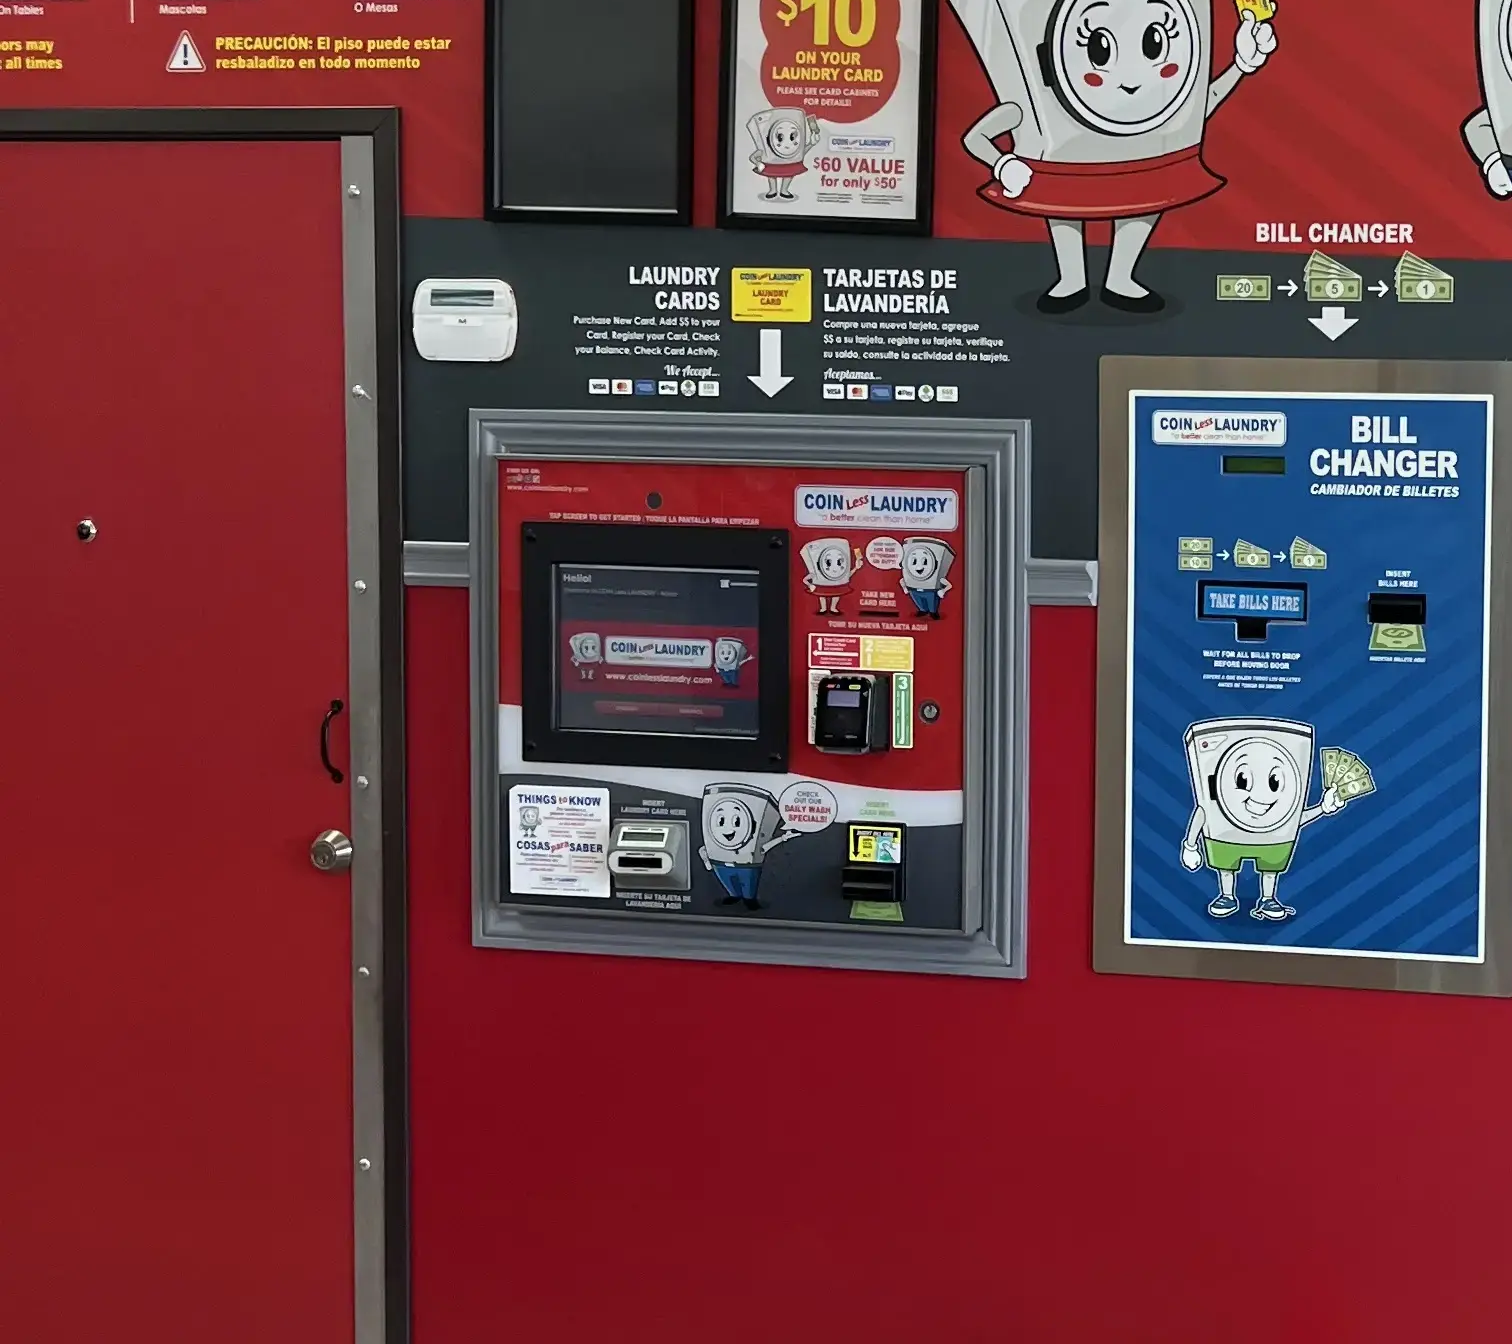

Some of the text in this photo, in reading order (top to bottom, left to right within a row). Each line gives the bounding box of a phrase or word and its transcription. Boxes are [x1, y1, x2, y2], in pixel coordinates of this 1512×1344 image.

[215, 34, 451, 53] PRECAUCIÓN: El piso puede estar
[215, 55, 420, 68] resbaladizo en todo momento
[795, 52, 861, 65] ON YOUR
[772, 67, 883, 82] LAUNDRY CARD
[813, 156, 905, 174] $60 VALUE
[1256, 222, 1413, 243] BILL CHANGER
[629, 266, 720, 285] LAUNDRY
[823, 268, 956, 288] TARJETAS DE
[655, 291, 720, 310] CARDS
[824, 290, 949, 313] LAVANDERÍA
[1351, 415, 1417, 443] BILL
[1310, 448, 1458, 478] CHANGER
[1310, 483, 1459, 497] CAMBIADOR DE BILLETES
[804, 494, 844, 511] COIN
[871, 496, 948, 513] LAUNDRY
[1209, 592, 1299, 611] TAKE BILLS HERE
